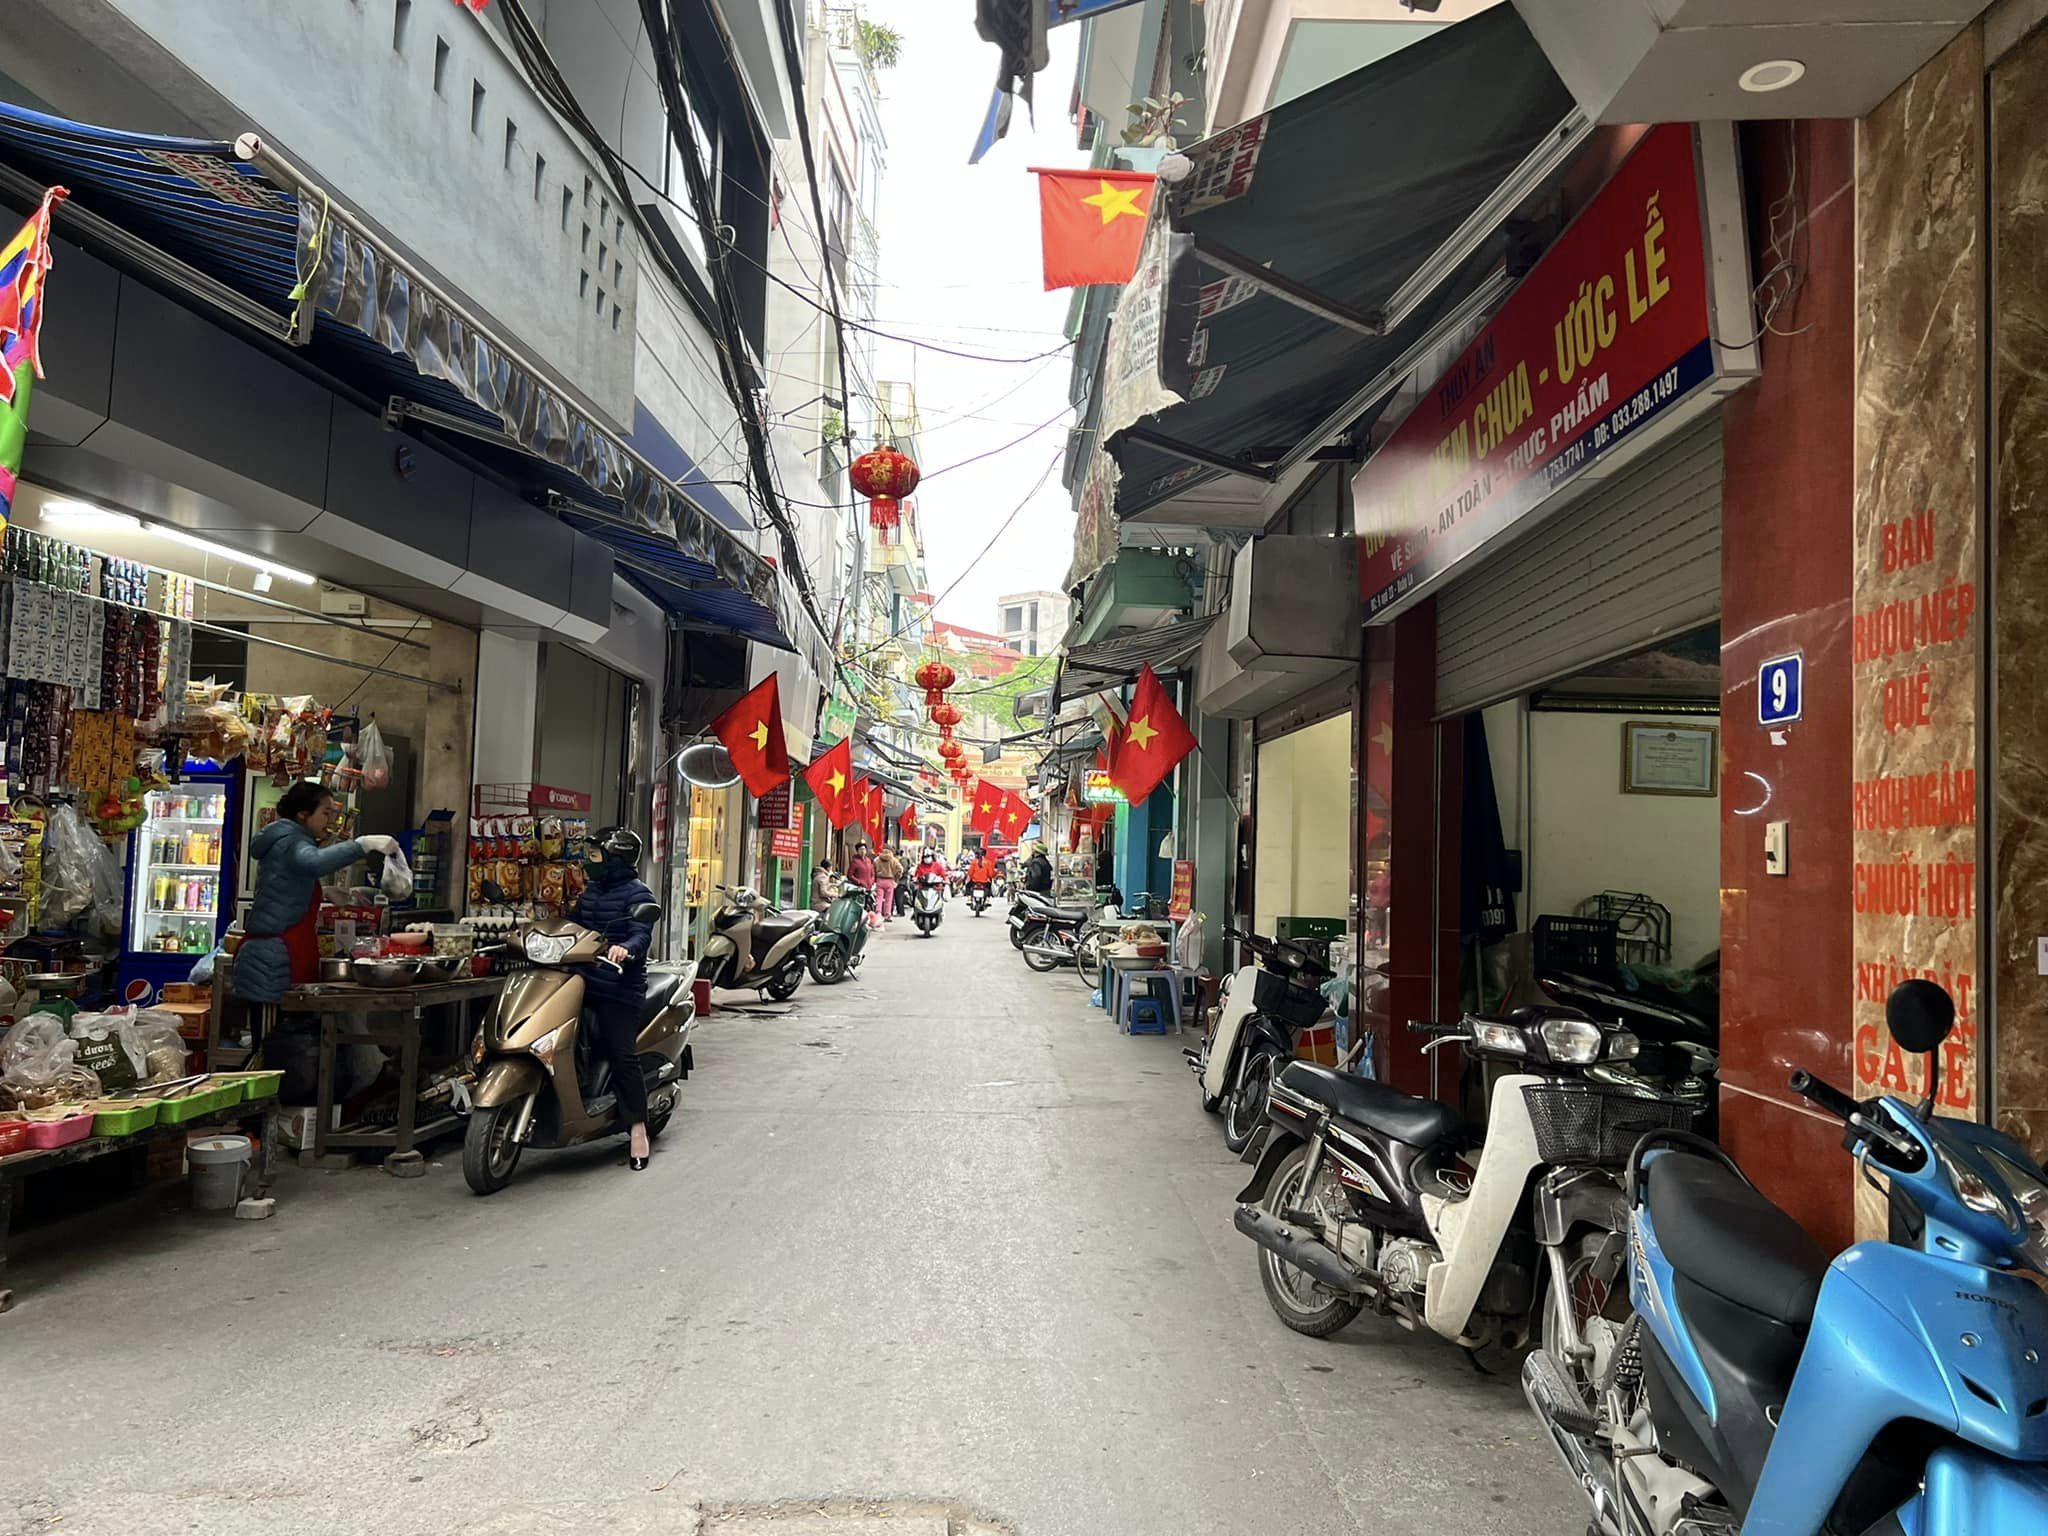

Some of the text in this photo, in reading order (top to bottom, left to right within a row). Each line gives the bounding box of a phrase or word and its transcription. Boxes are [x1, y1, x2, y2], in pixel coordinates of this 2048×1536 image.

[1474, 360, 1533, 460] CHUA
[1555, 274, 1617, 385] ƯỚC
[1624, 188, 1671, 324] LỄ
[1612, 366, 1679, 436] 033.288.1497
[1439, 507, 1455, 534] AN
[1458, 480, 1492, 518] TOÀN
[1504, 428, 1547, 479] THỰC
[1550, 372, 1609, 444] PHẨM
[1772, 668, 1787, 712] 9
[1954, 1291, 2018, 1313] HONDA
